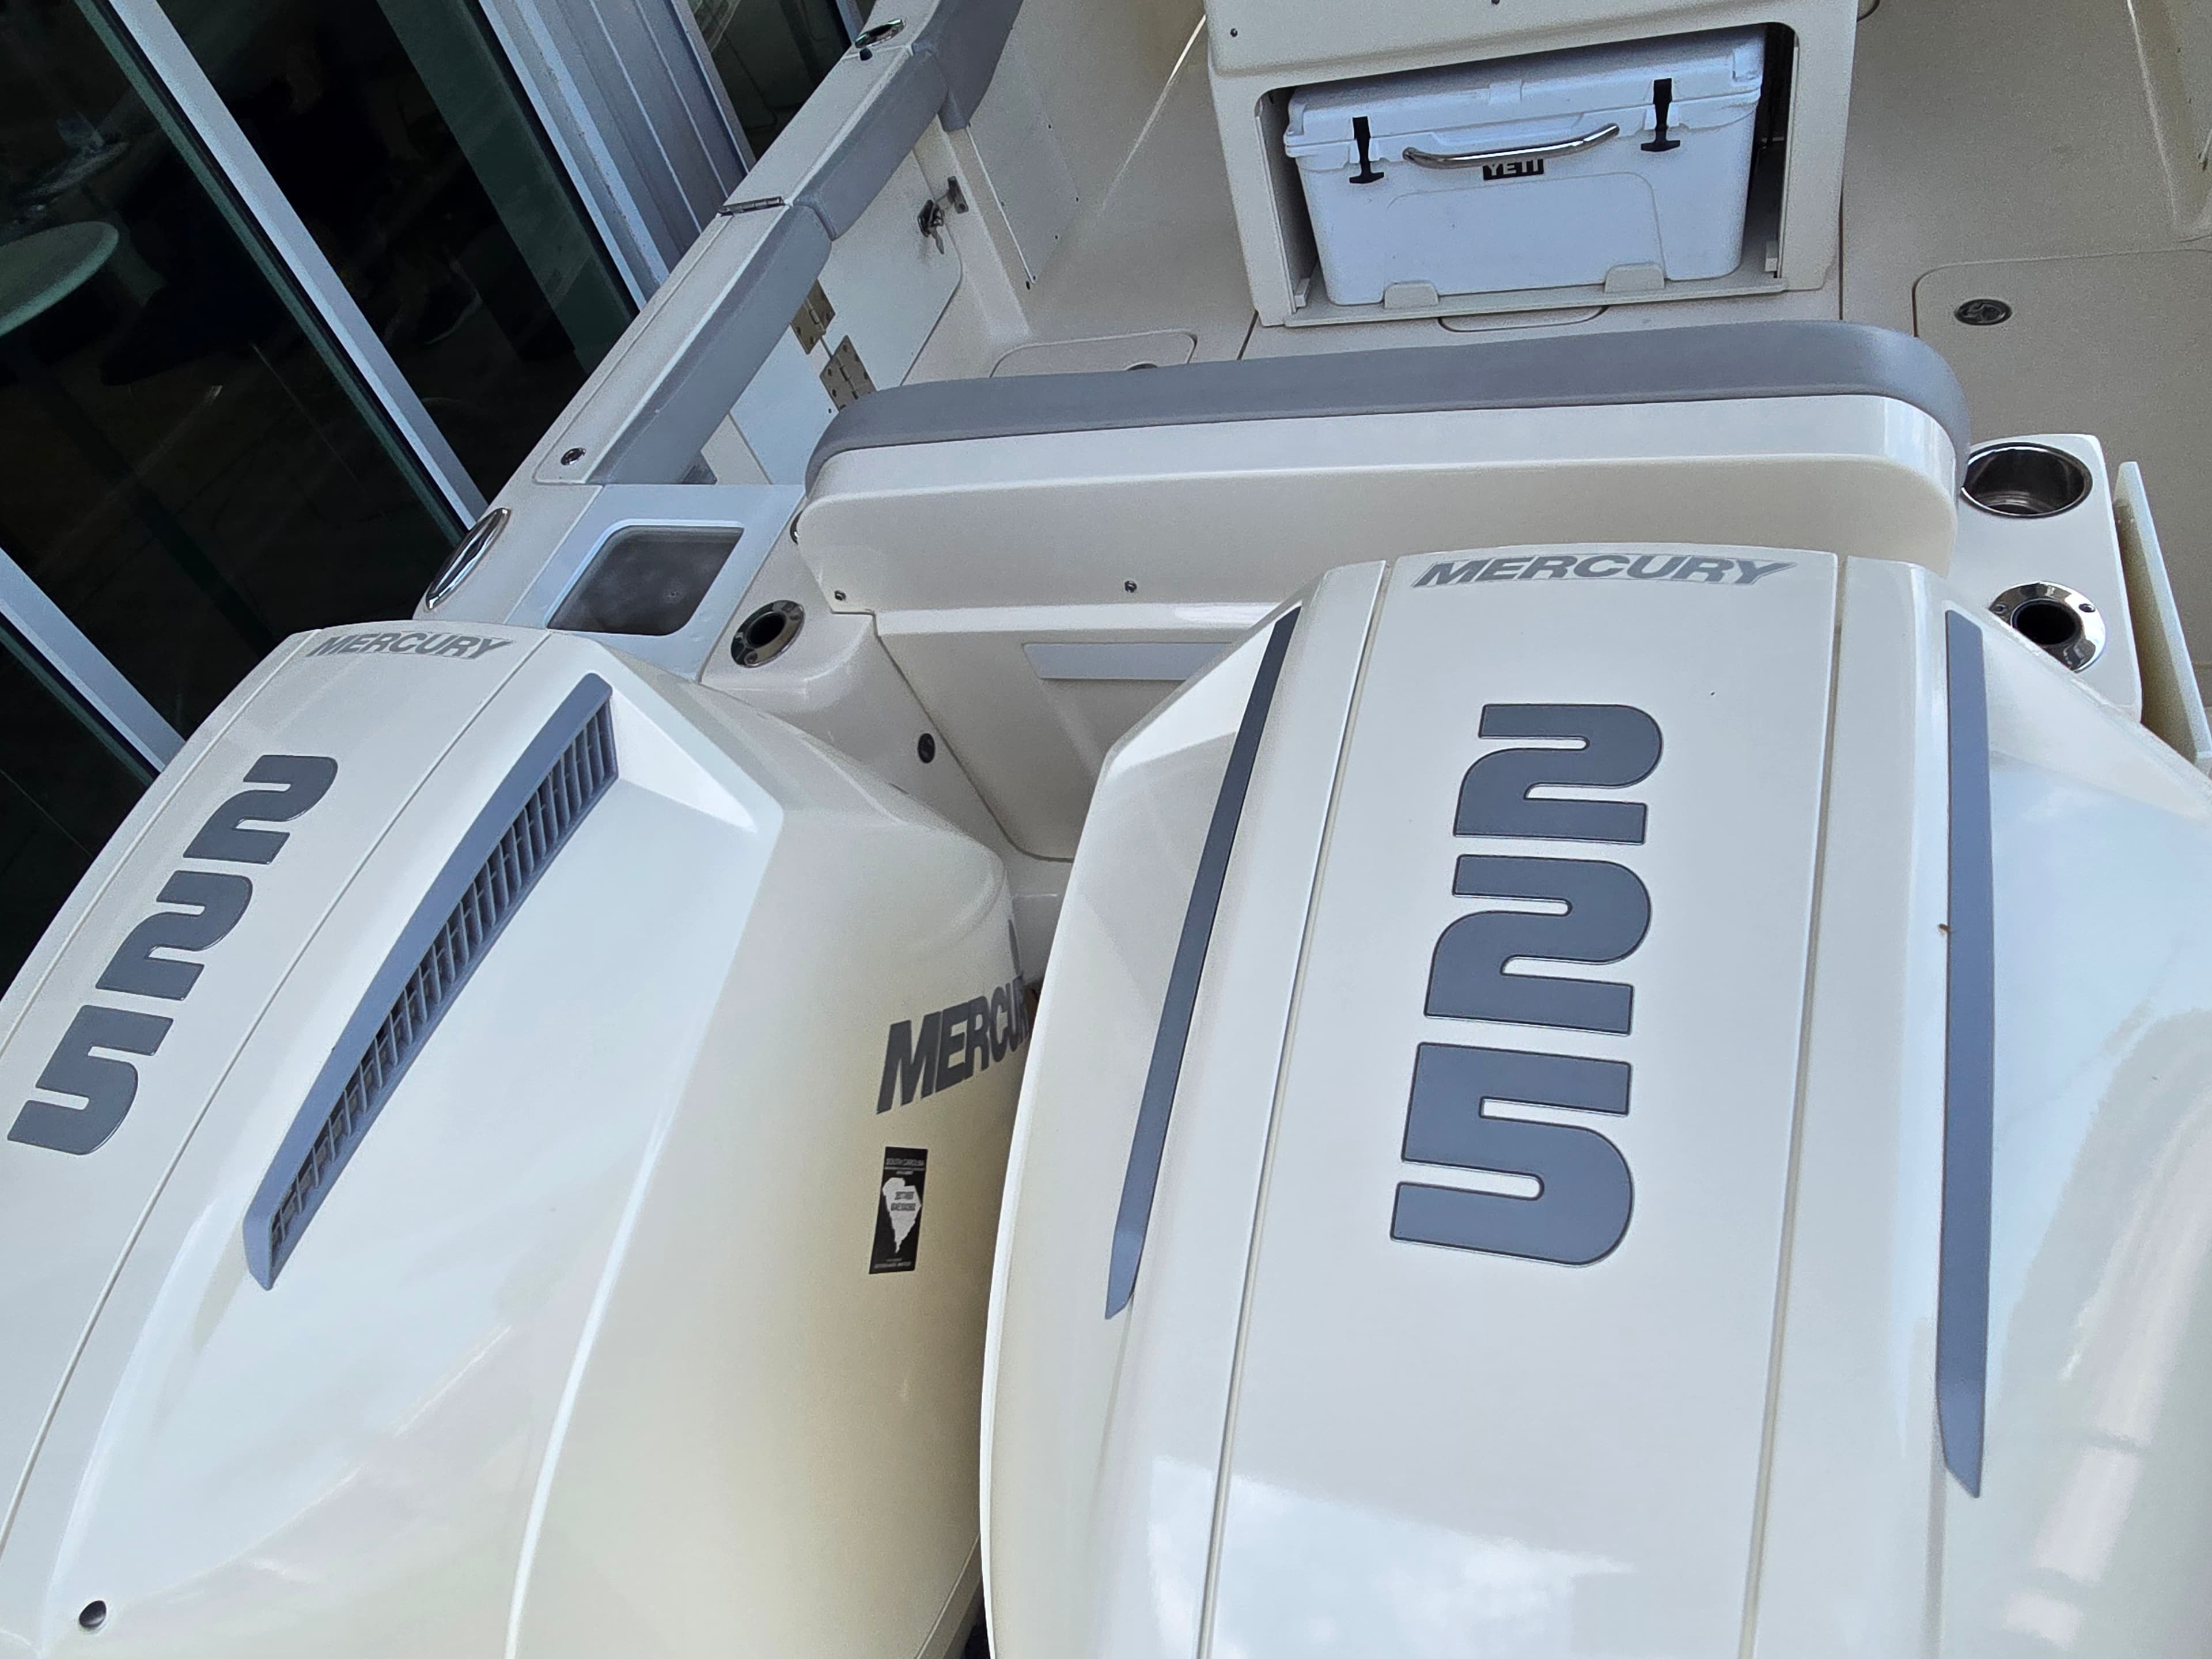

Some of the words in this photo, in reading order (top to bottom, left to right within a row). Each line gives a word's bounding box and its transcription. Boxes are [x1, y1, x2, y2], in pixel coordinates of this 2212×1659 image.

[1485, 158, 1540, 176] YETI
[1411, 554, 1798, 587] MERCURY
[305, 632, 514, 660] MERCURY
[7, 755, 339, 1156] 225
[1390, 703, 1663, 1267] 225
